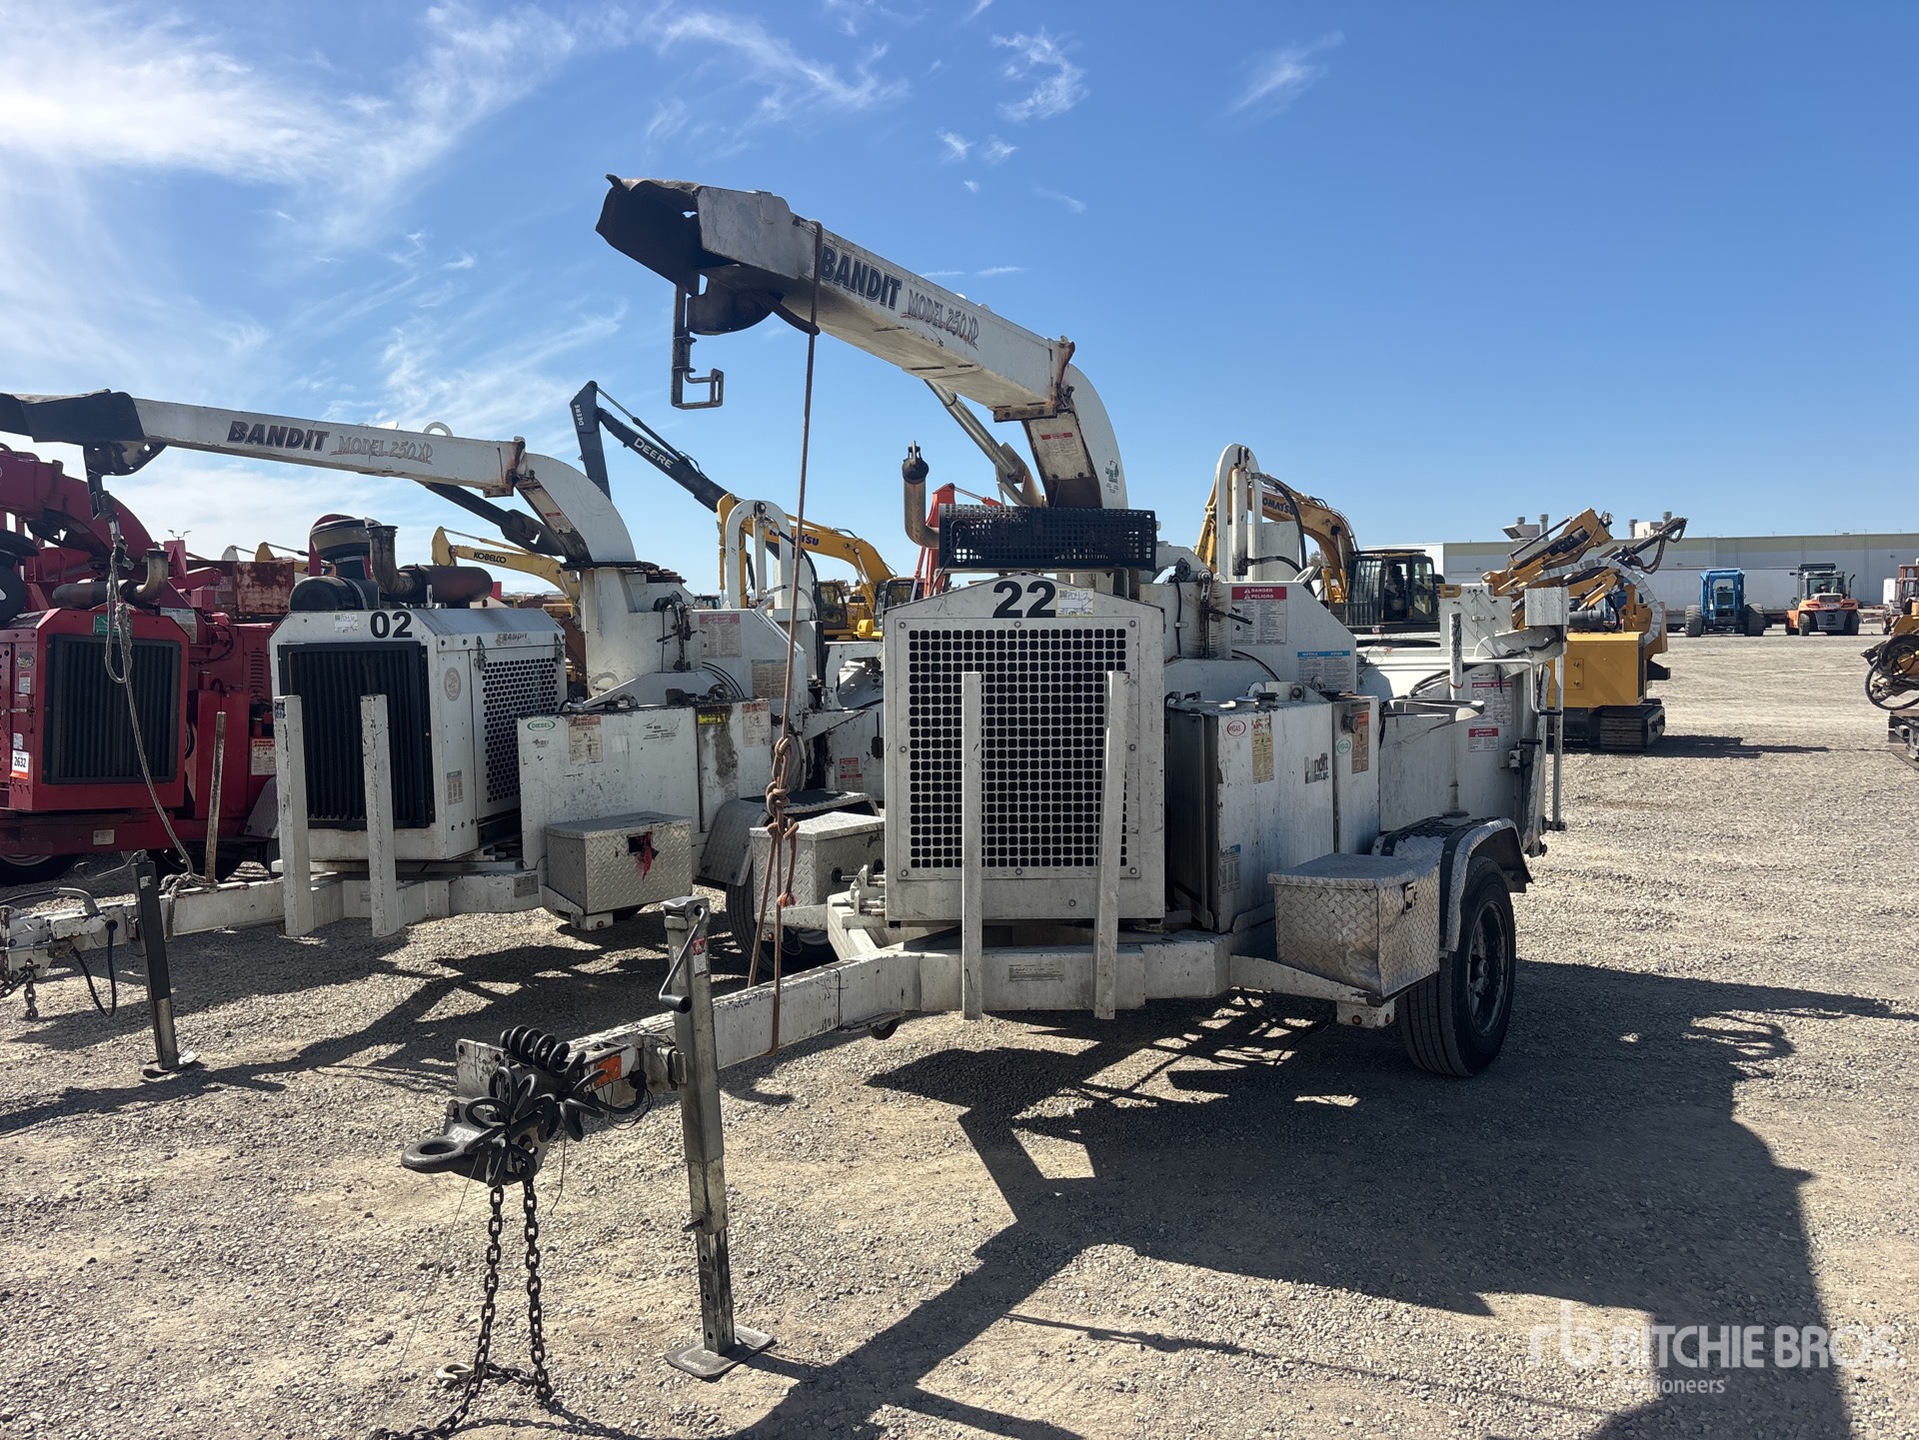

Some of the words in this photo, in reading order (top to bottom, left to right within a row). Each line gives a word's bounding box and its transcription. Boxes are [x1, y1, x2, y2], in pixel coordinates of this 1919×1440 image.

[819, 244, 903, 311] BANDIT
[907, 288, 945, 328] MODEL
[574, 404, 584, 426] DEERE
[226, 420, 330, 452] BANDIT
[336, 435, 387, 457] MODEL
[633, 437, 674, 469] DEERE
[1261, 497, 1296, 516] OMATS
[473, 551, 507, 564] KOBELCO
[992, 580, 1056, 618] 22
[370, 611, 413, 639] 02
[14, 756, 27, 768] 2632
